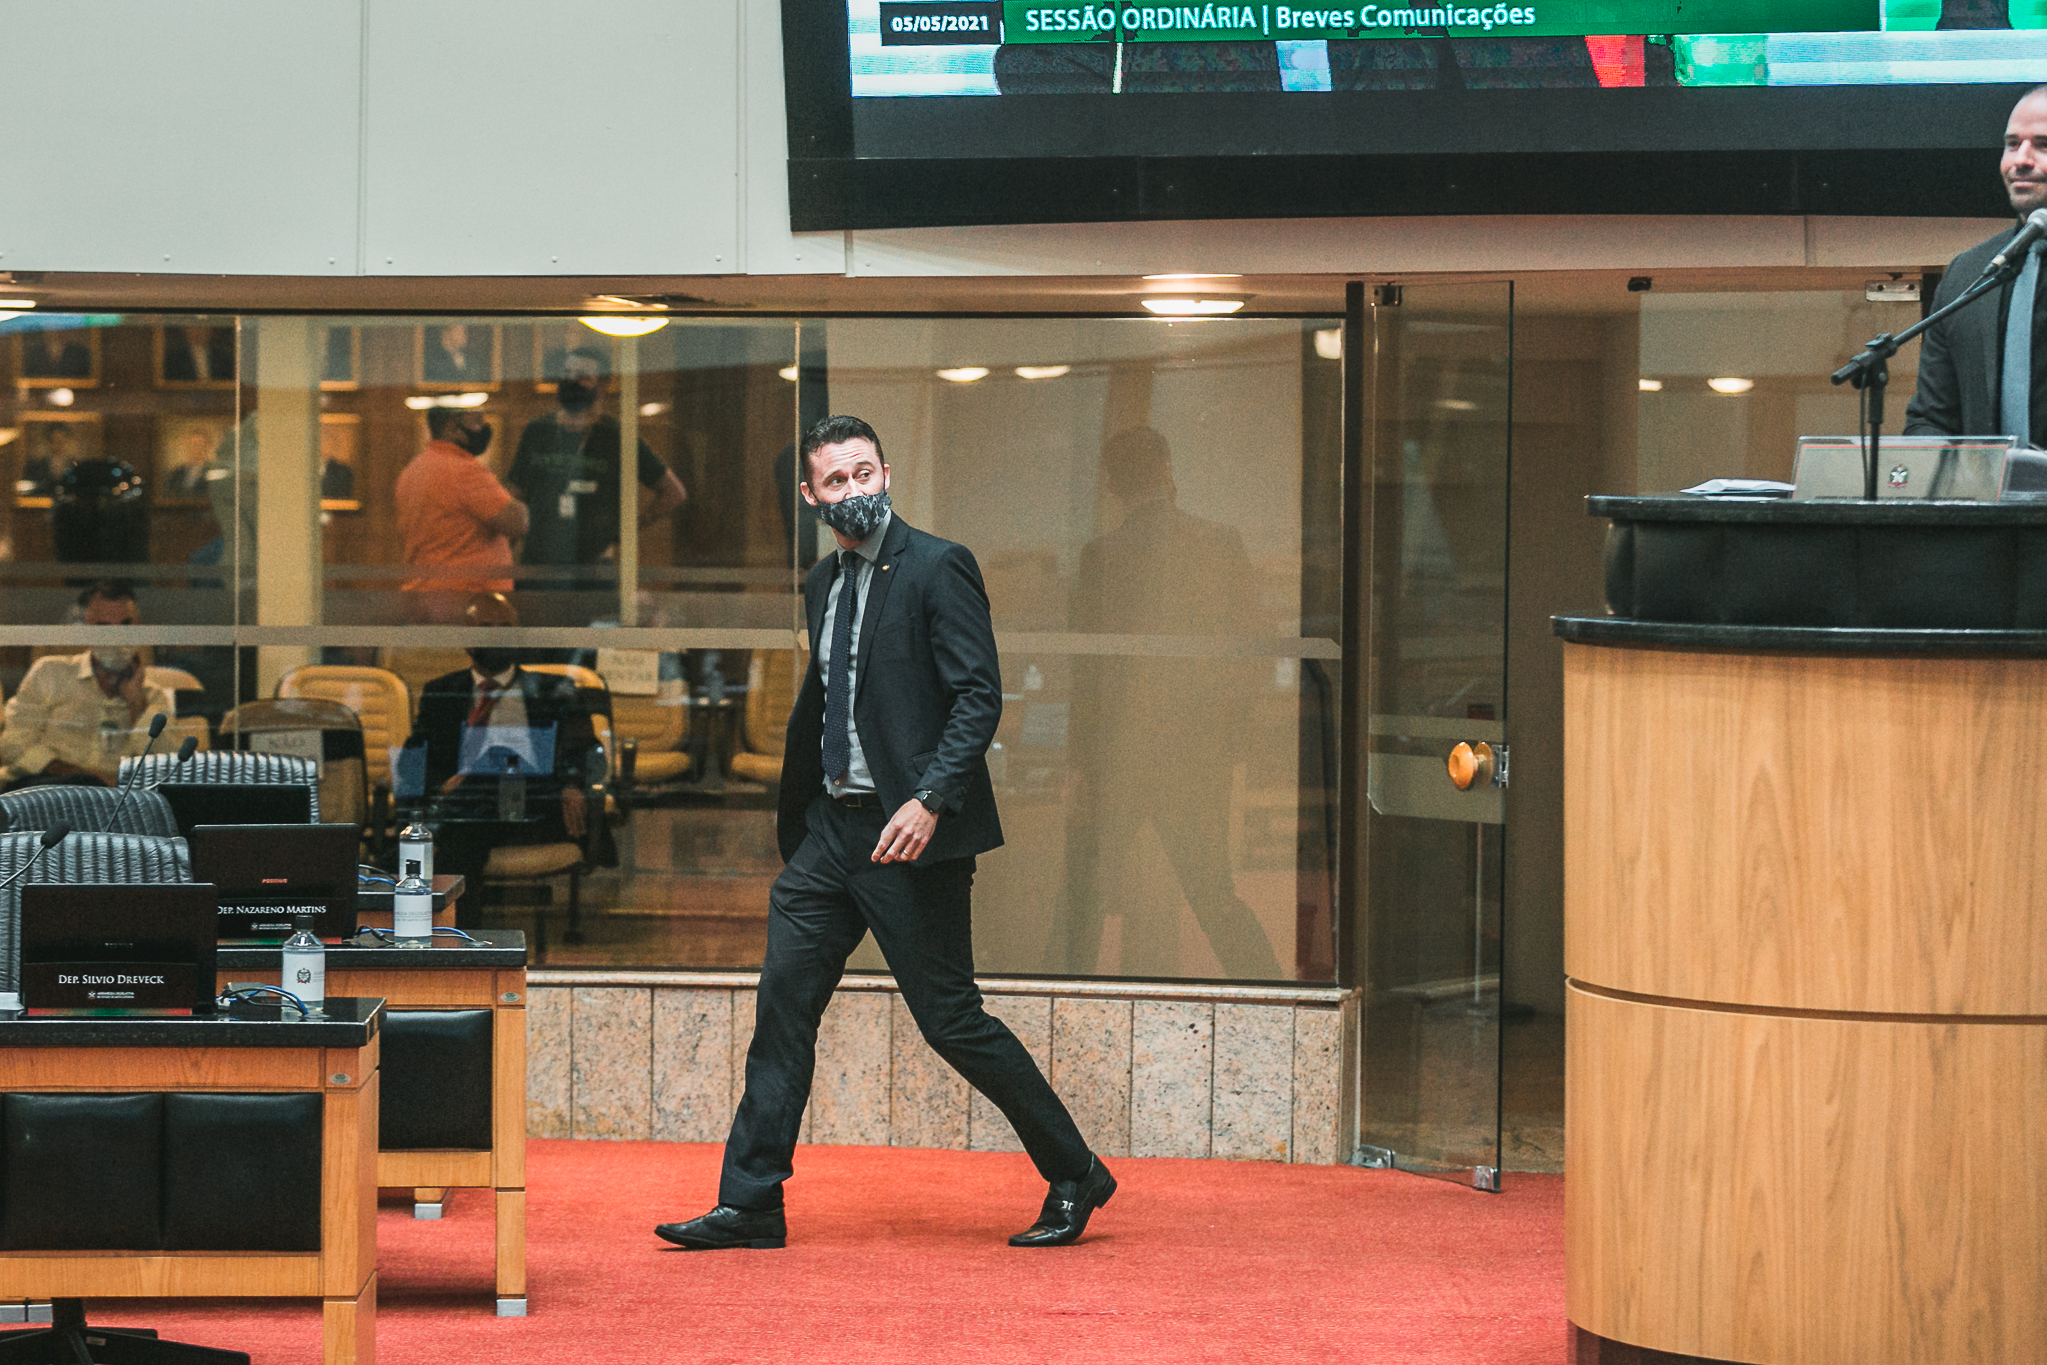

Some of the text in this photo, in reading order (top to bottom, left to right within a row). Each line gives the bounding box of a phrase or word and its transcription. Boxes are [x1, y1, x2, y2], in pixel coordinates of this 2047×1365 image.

[890, 15, 989, 32] 05/05/2021
[1025, 3, 1116, 31] SESSÃO
[1122, 2, 1258, 30] ORDINÁRIA
[1276, 6, 1355, 28] Breves
[1361, 3, 1536, 31] Comunicações
[236, 905, 285, 914] NAZARENO
[286, 905, 327, 914] MARTINS
[58, 974, 165, 985] DEP. SILVIO DREVECK
